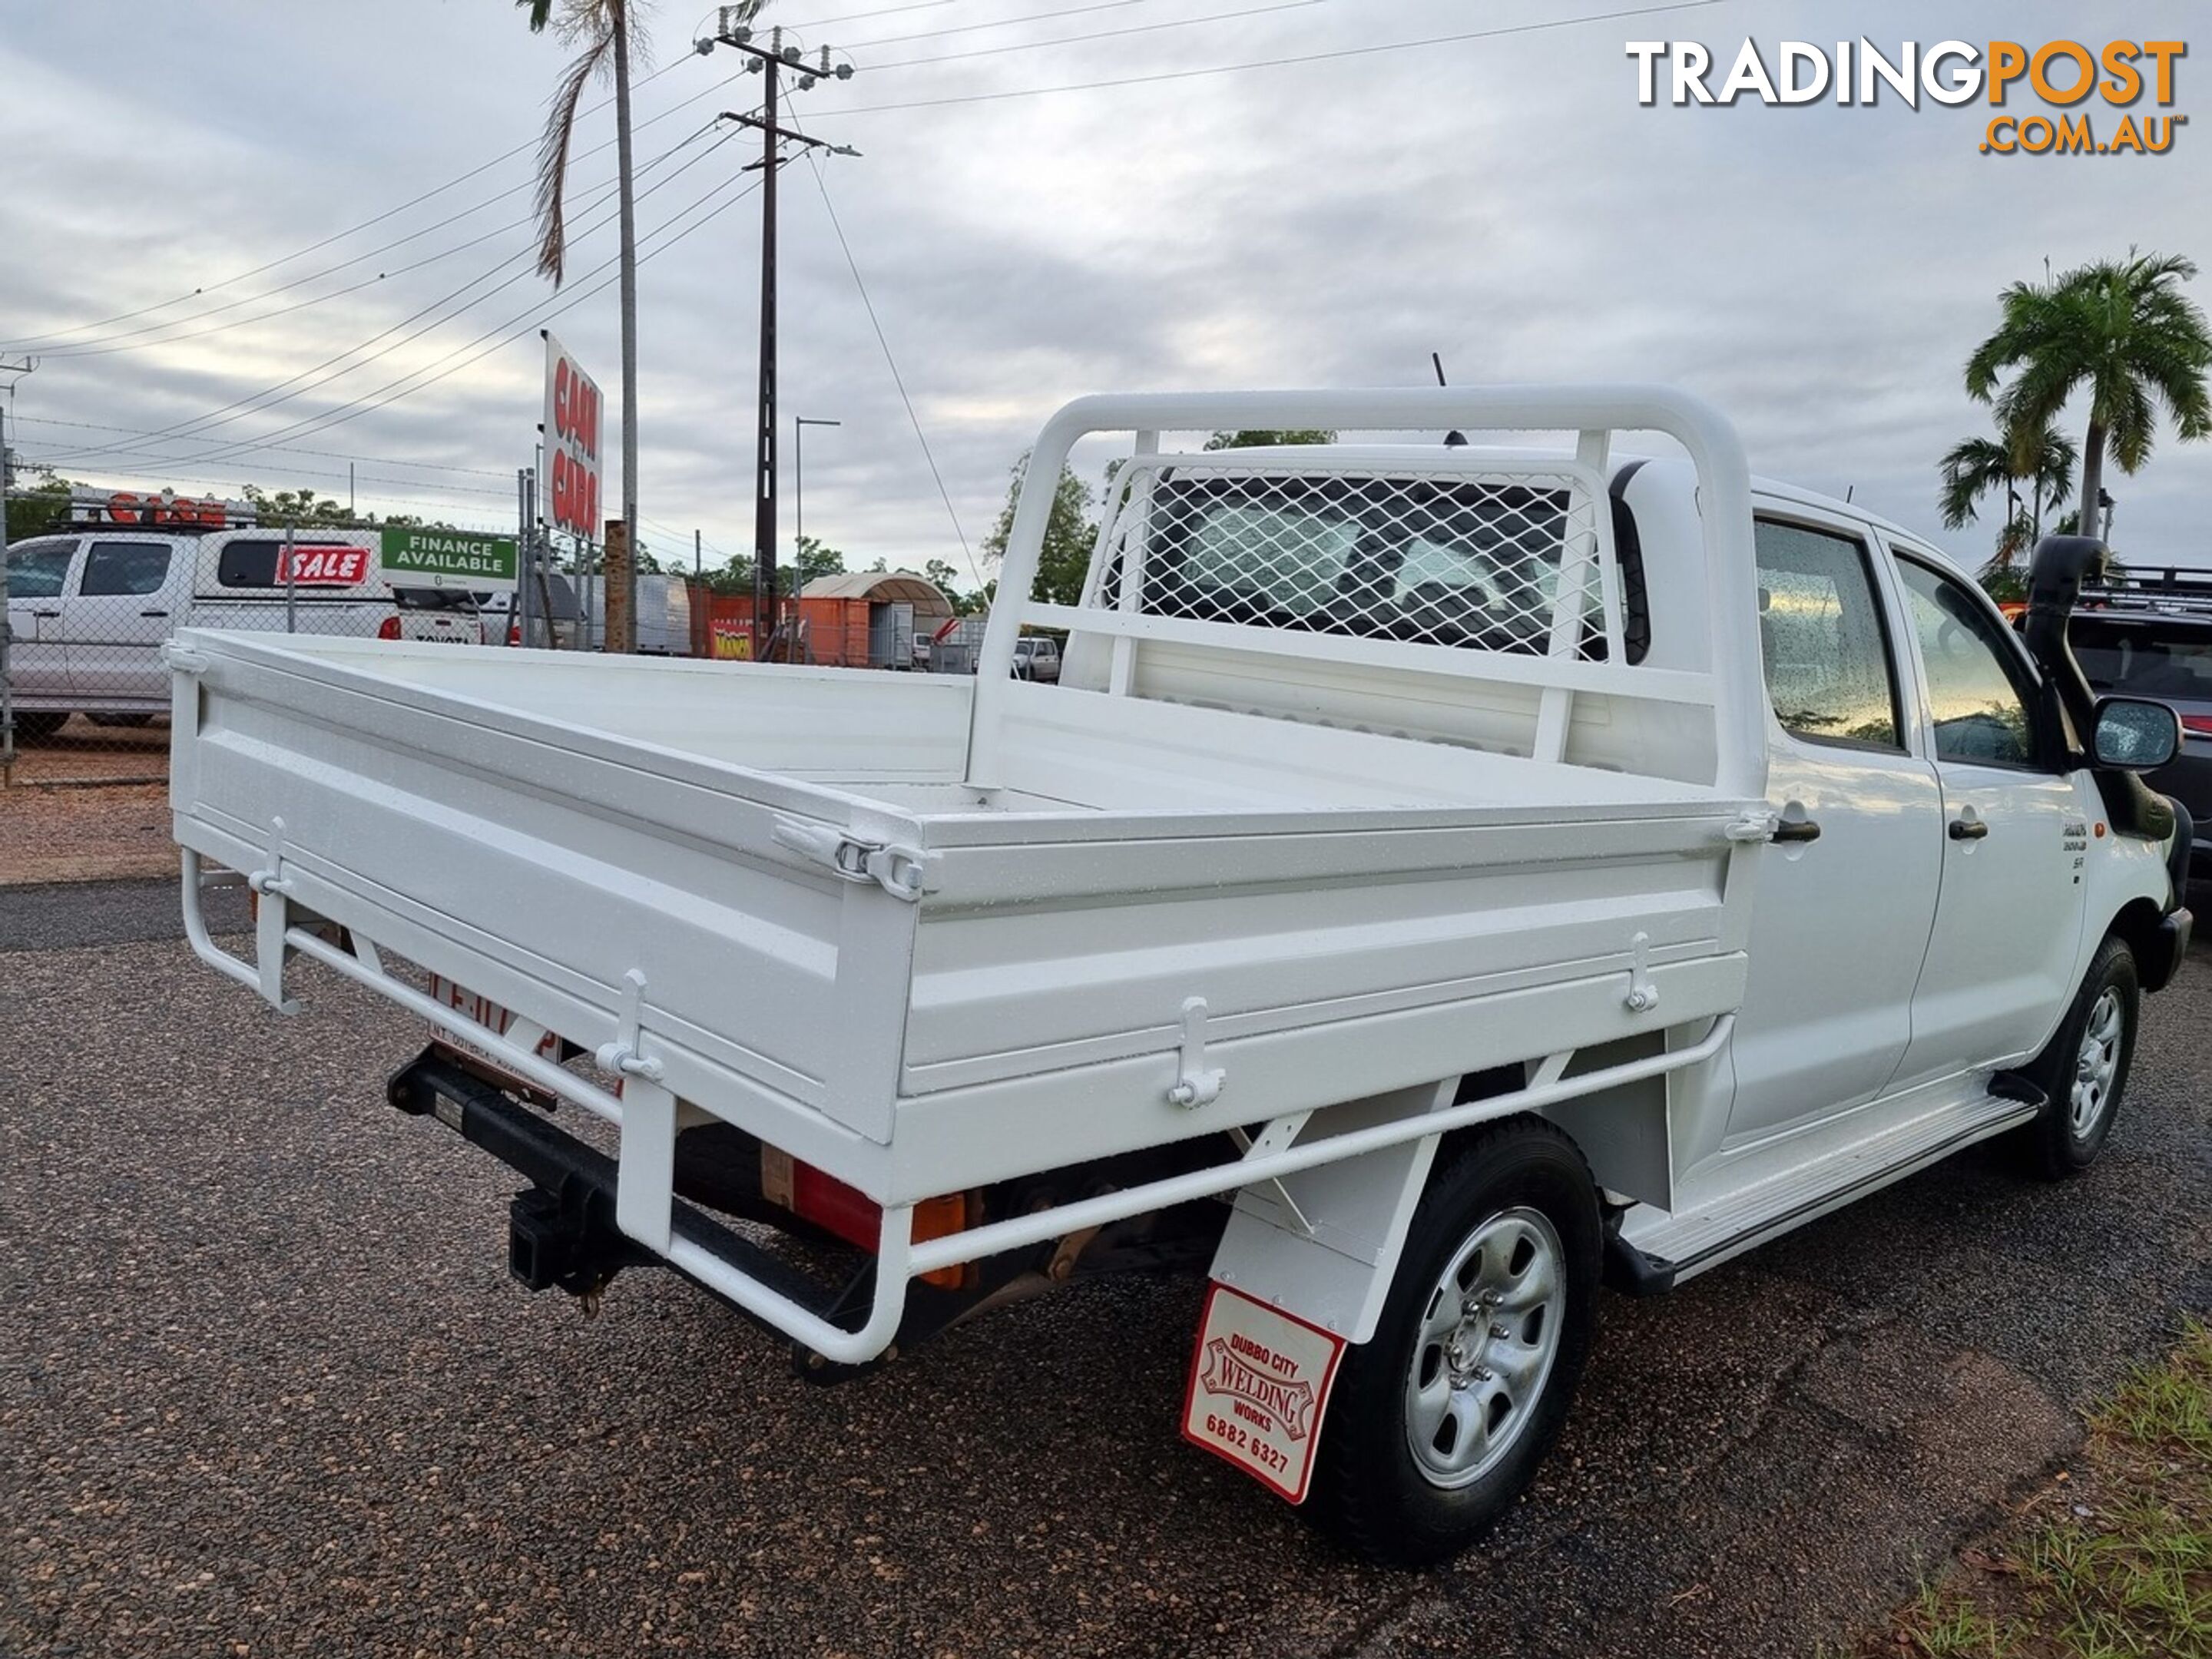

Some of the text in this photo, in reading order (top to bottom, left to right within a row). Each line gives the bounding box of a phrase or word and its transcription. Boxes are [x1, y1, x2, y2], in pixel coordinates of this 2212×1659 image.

[397, 551, 503, 572] AVAILABLE
[409, 536, 492, 556] FINANCE
[286, 553, 361, 578] SALE
[1231, 1333, 1299, 1379] DUBBO CITY
[1221, 1355, 1298, 1423] WELDING
[1233, 1400, 1273, 1432] WORKS
[1207, 1414, 1289, 1473] 6882 6327
